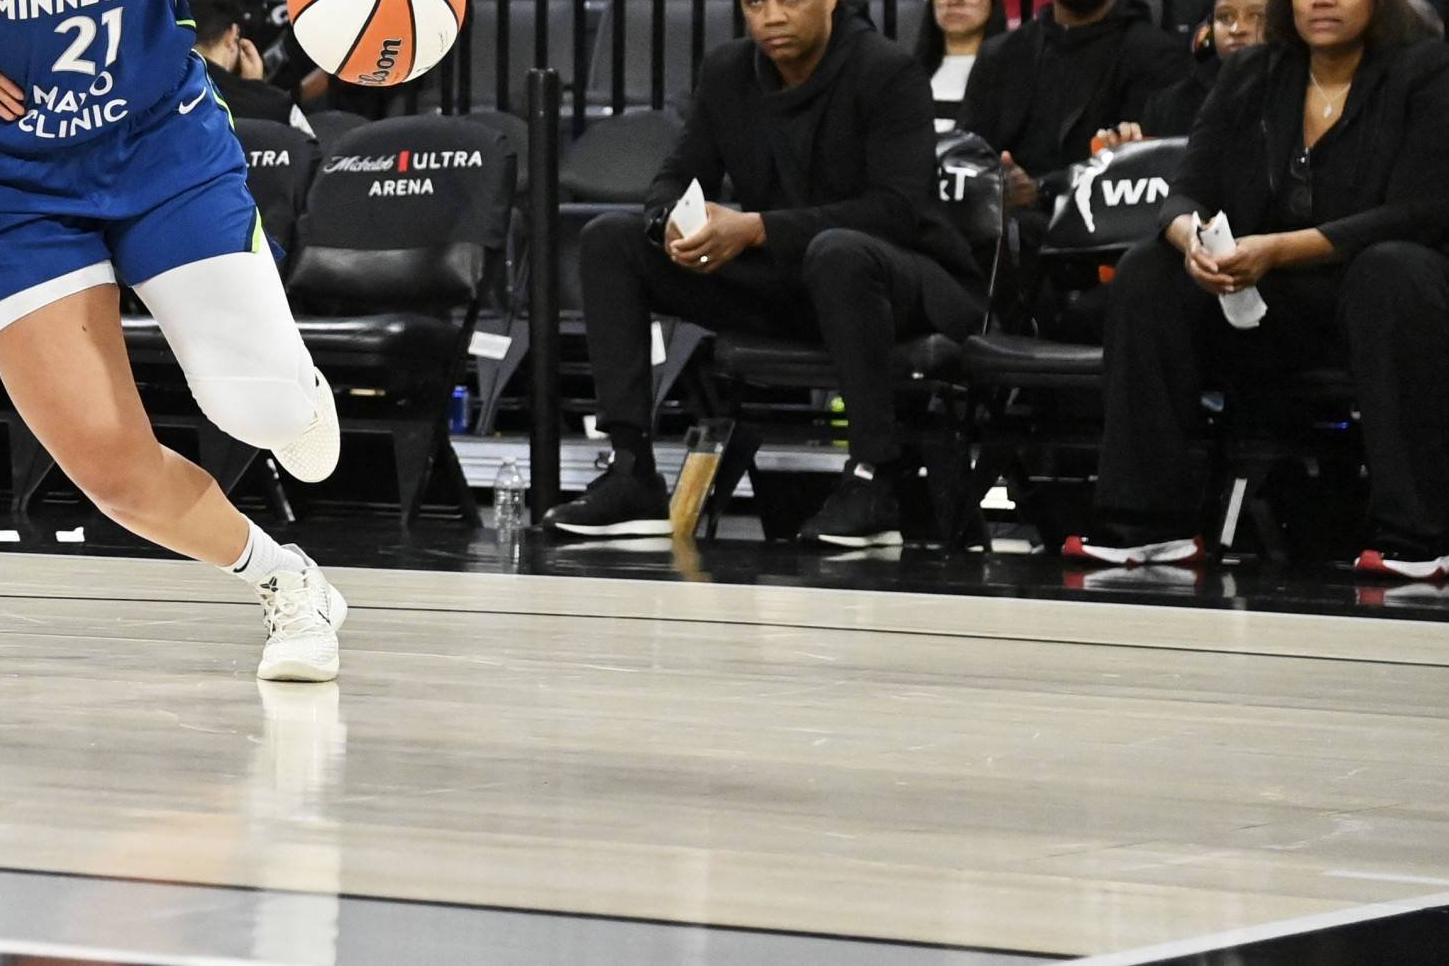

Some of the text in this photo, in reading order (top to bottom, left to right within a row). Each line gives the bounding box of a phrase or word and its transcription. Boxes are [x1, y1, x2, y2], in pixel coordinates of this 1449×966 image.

[51, 6, 124, 76] 21
[358, 37, 404, 85] lson
[18, 98, 129, 139] CLINIC
[247, 150, 291, 168] TRA
[323, 149, 483, 174] Michelob ULTRA
[368, 178, 434, 197] ARENA
[1101, 176, 1170, 207] WN
